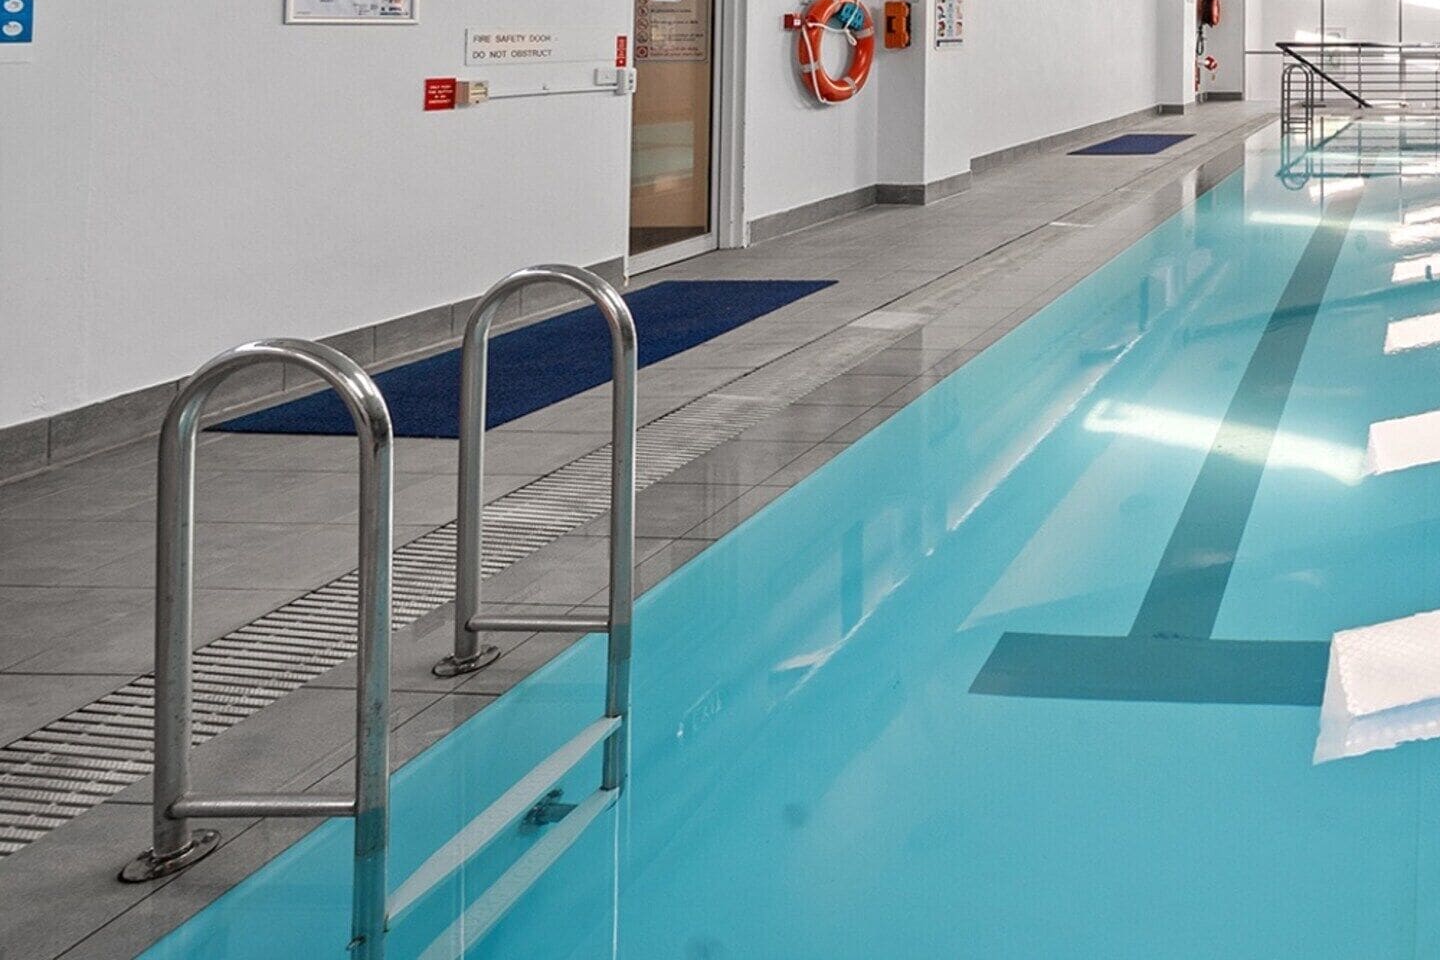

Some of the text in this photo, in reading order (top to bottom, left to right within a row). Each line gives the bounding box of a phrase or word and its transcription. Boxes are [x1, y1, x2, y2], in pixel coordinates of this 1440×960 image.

[495, 34, 526, 43] SAFETY
[472, 49, 552, 60] DO NOT OBSTRUCT
